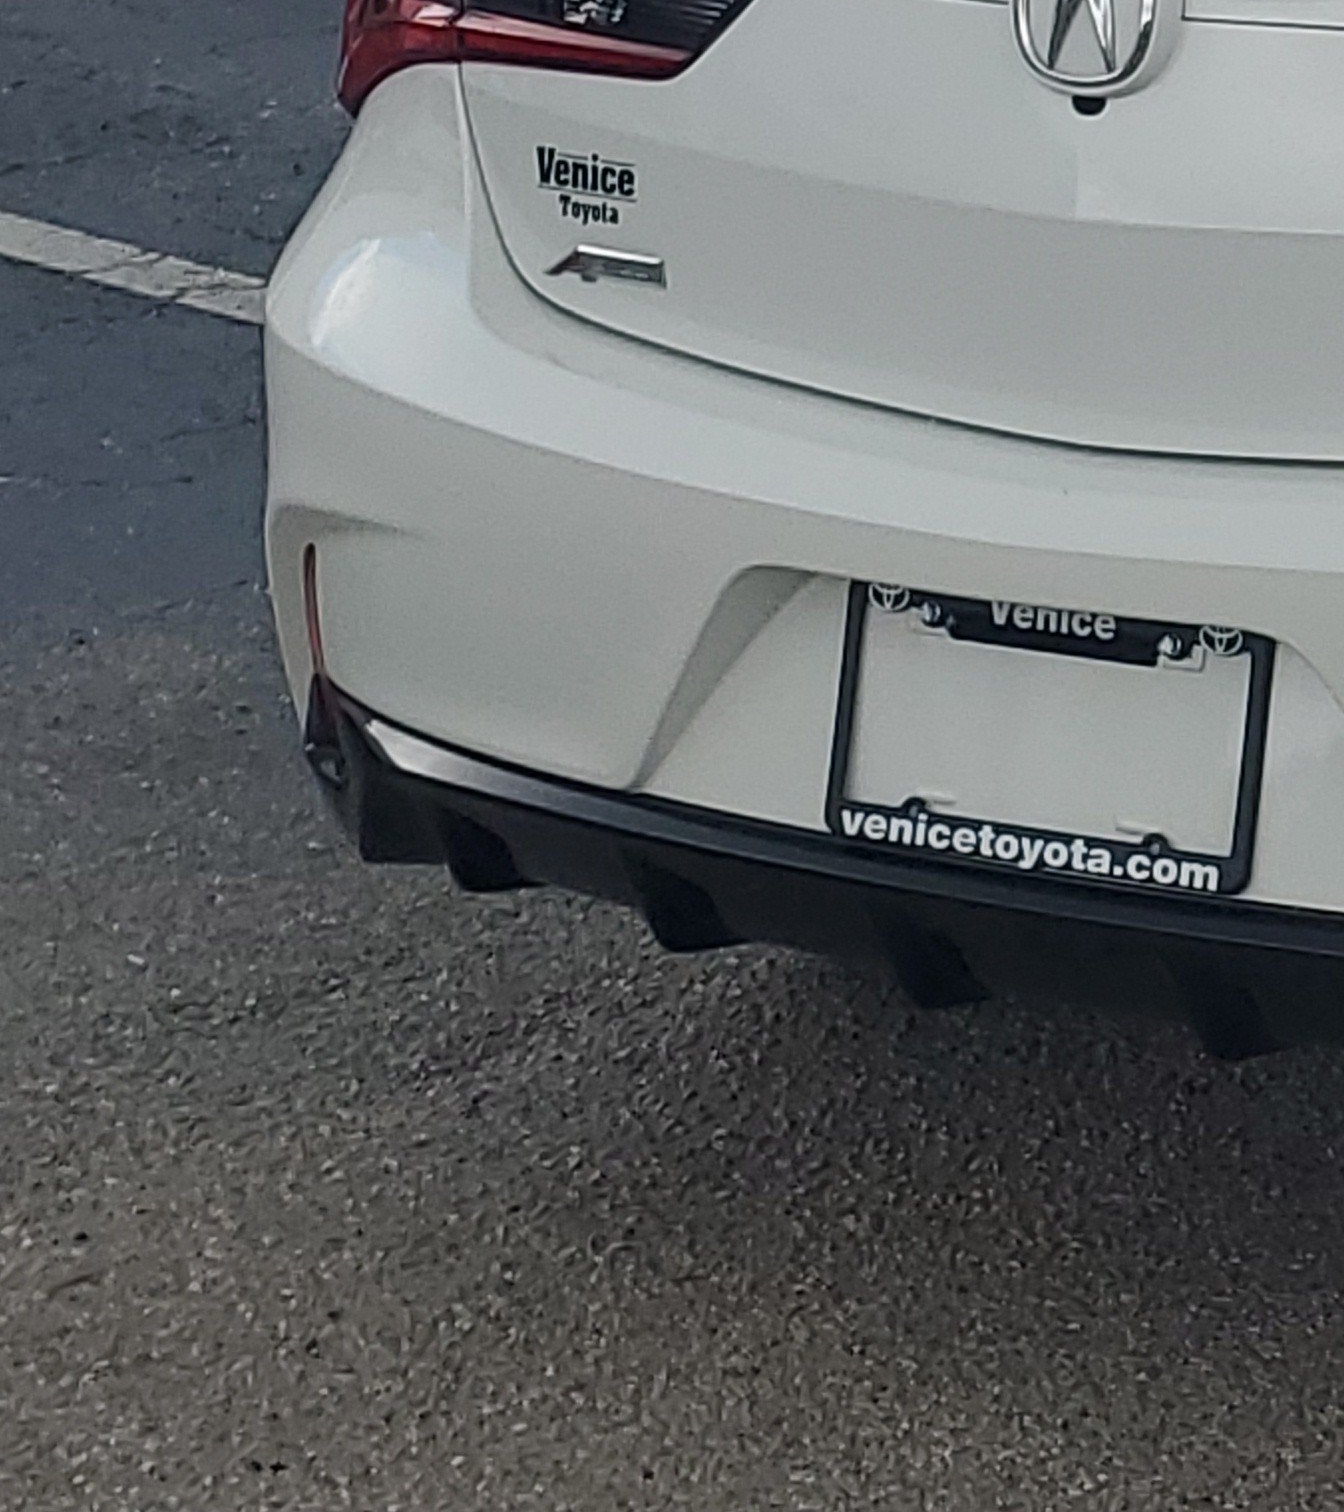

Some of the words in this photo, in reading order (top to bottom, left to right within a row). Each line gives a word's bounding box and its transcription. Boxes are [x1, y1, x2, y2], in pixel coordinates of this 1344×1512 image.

[536, 145, 636, 197] Venice
[558, 193, 620, 226] Toyota
[989, 600, 1117, 641] Venice
[840, 807, 1221, 893] venicetoyota.com
